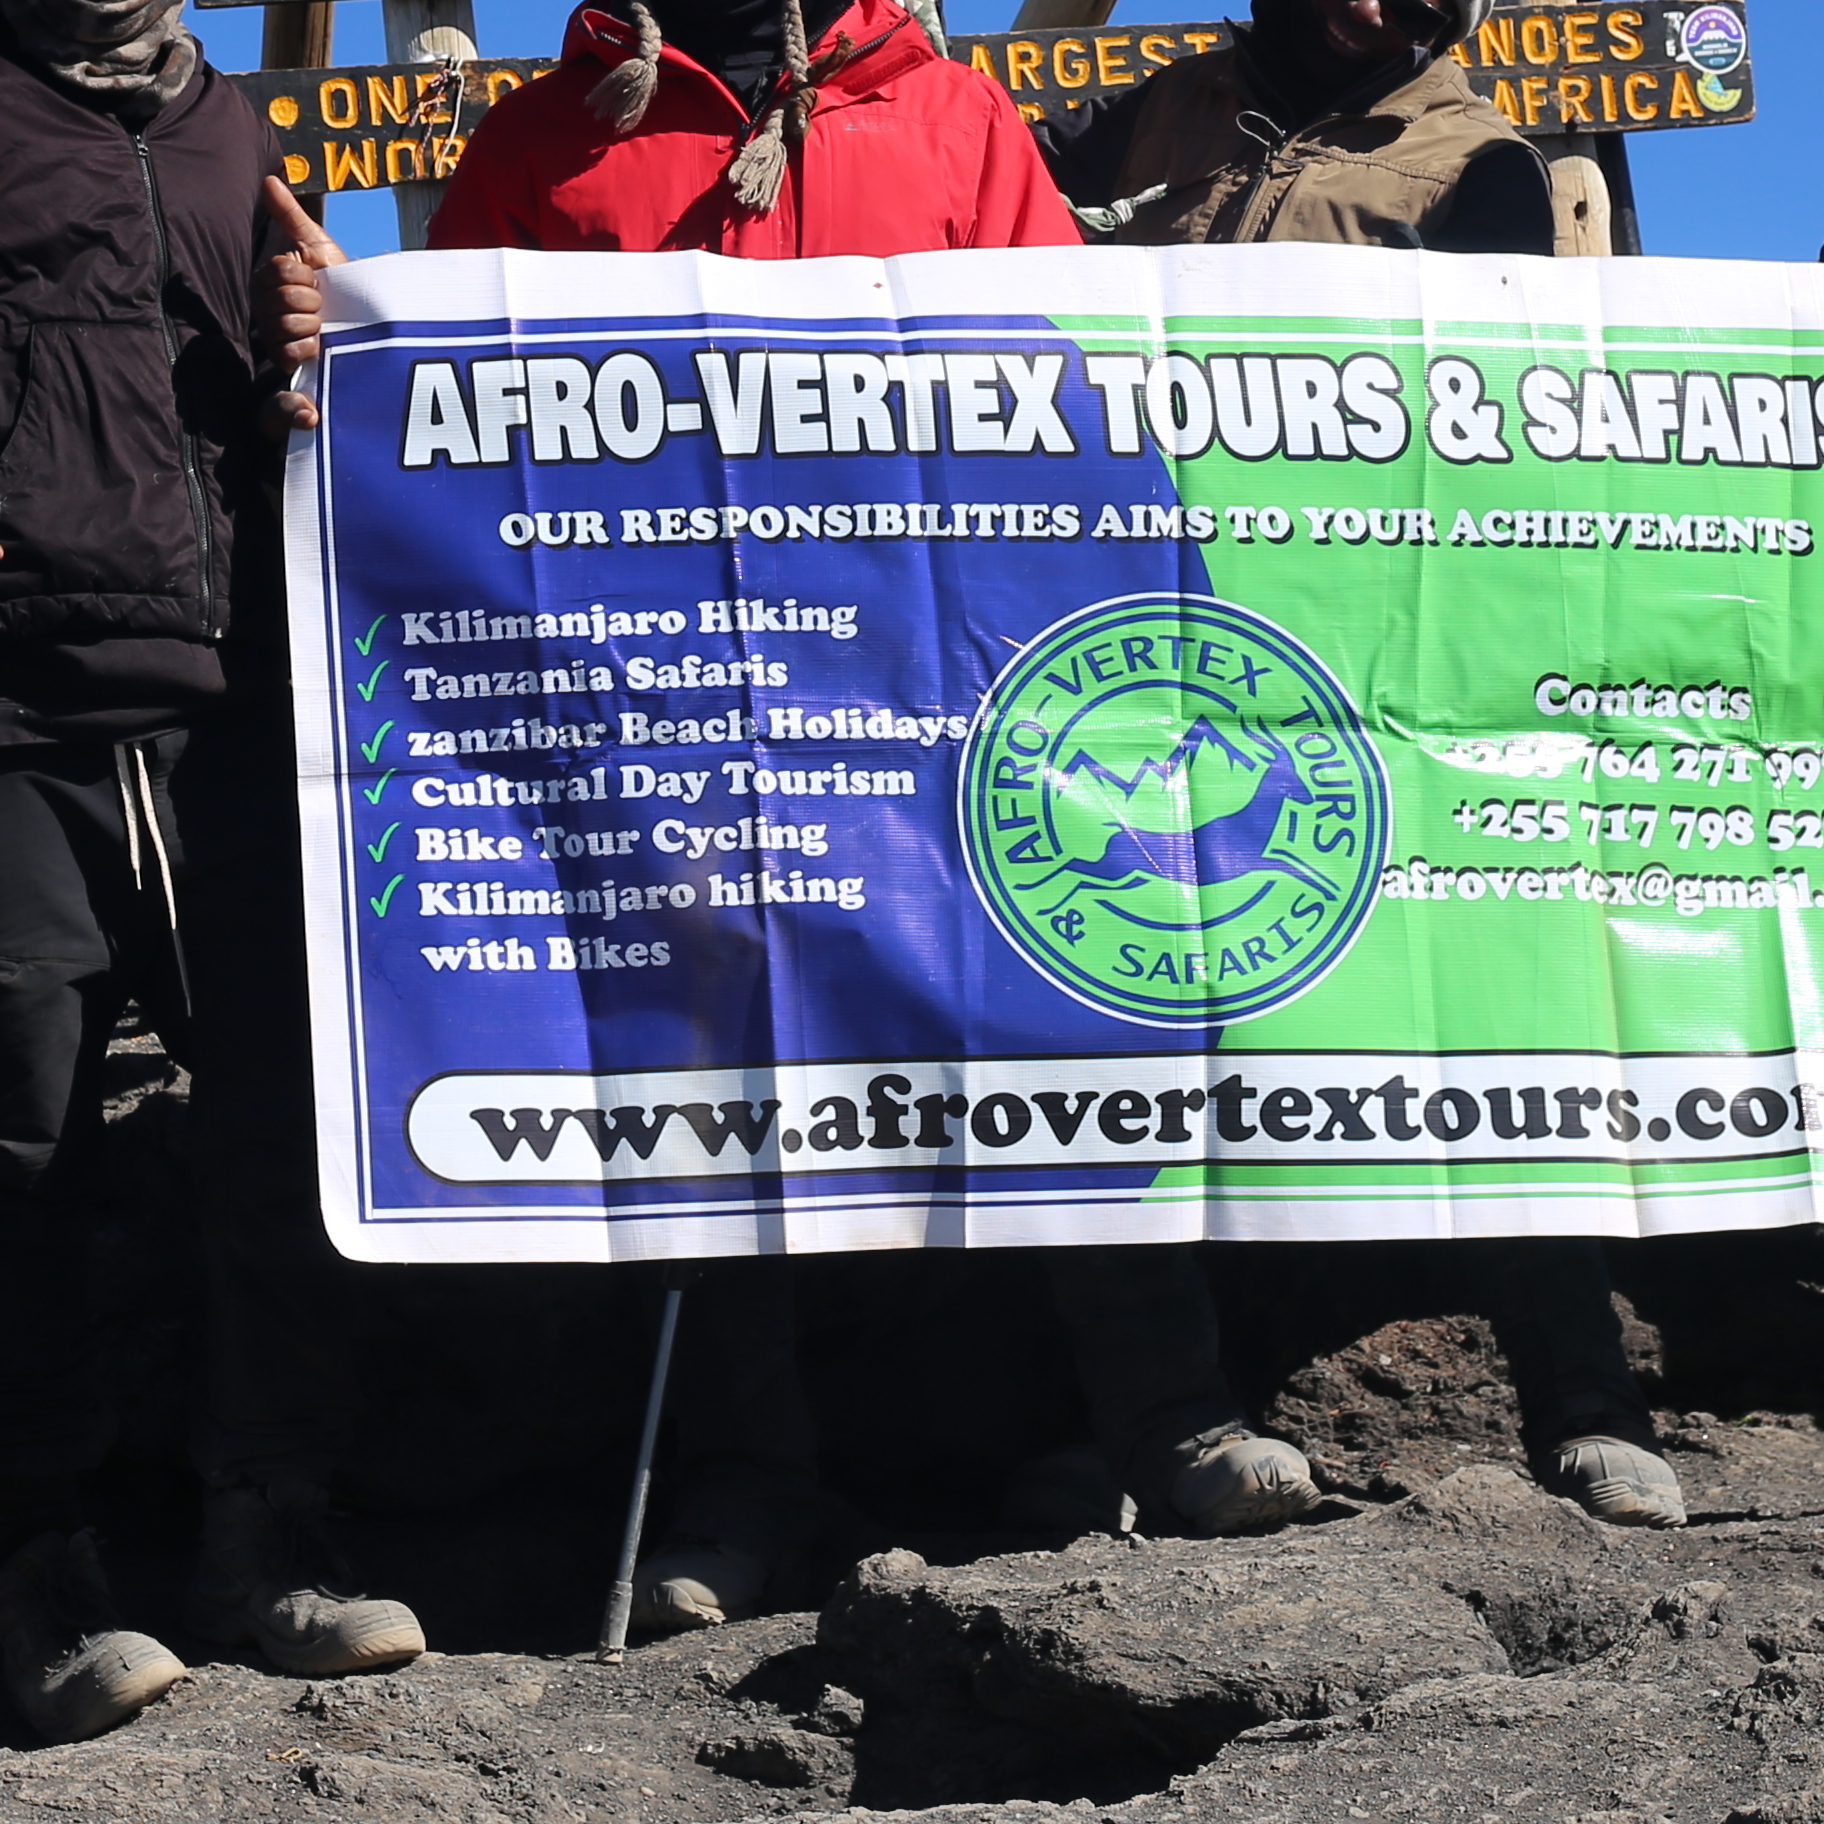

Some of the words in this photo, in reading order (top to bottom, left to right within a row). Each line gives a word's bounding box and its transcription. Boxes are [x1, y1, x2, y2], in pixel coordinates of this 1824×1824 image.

[320, 73, 453, 129] ONE
[970, 31, 1220, 91] ARGEST
[1493, 70, 1705, 127] AFRICA
[401, 349, 1078, 469] AFRO-VERTEX
[1084, 350, 1409, 463] TOURS
[1424, 355, 1513, 464] &
[498, 511, 610, 548] OUR
[620, 501, 1082, 546] RESPONSIBILITIES
[1091, 503, 1216, 544] AIMS
[1224, 504, 1292, 545] TO
[1307, 506, 1439, 547] YOUR
[1446, 508, 1816, 557] ACHIEVEMENTS
[401, 604, 686, 645] Kilimanjaro
[697, 598, 859, 640] Hiking
[403, 658, 615, 701] Tanzania
[625, 653, 789, 692] Safaris
[1534, 672, 1754, 724] Contacts
[407, 717, 607, 758] zanzibar
[618, 709, 757, 747] Beach
[766, 707, 969, 746] Holidays
[991, 633, 1274, 864] AFRO-VERTEX
[411, 766, 607, 808] Cultural
[619, 764, 711, 804] Day
[722, 761, 917, 797] Tourism
[1279, 694, 1358, 859] TOURS
[1577, 738, 1661, 784] 764
[1670, 742, 1753, 788] 271
[415, 825, 523, 862] Bike
[532, 824, 641, 860] Tour
[651, 817, 829, 860] Cycling
[1452, 797, 1572, 843] +255
[1579, 802, 1659, 849] 717
[1670, 804, 1756, 852] 798
[418, 877, 697, 921] Kilimanjaro
[708, 870, 867, 912] hiking
[420, 937, 536, 973] with
[546, 933, 671, 971] Bikes
[1050, 908, 1086, 948] &
[1111, 892, 1327, 985] SAFARIS
